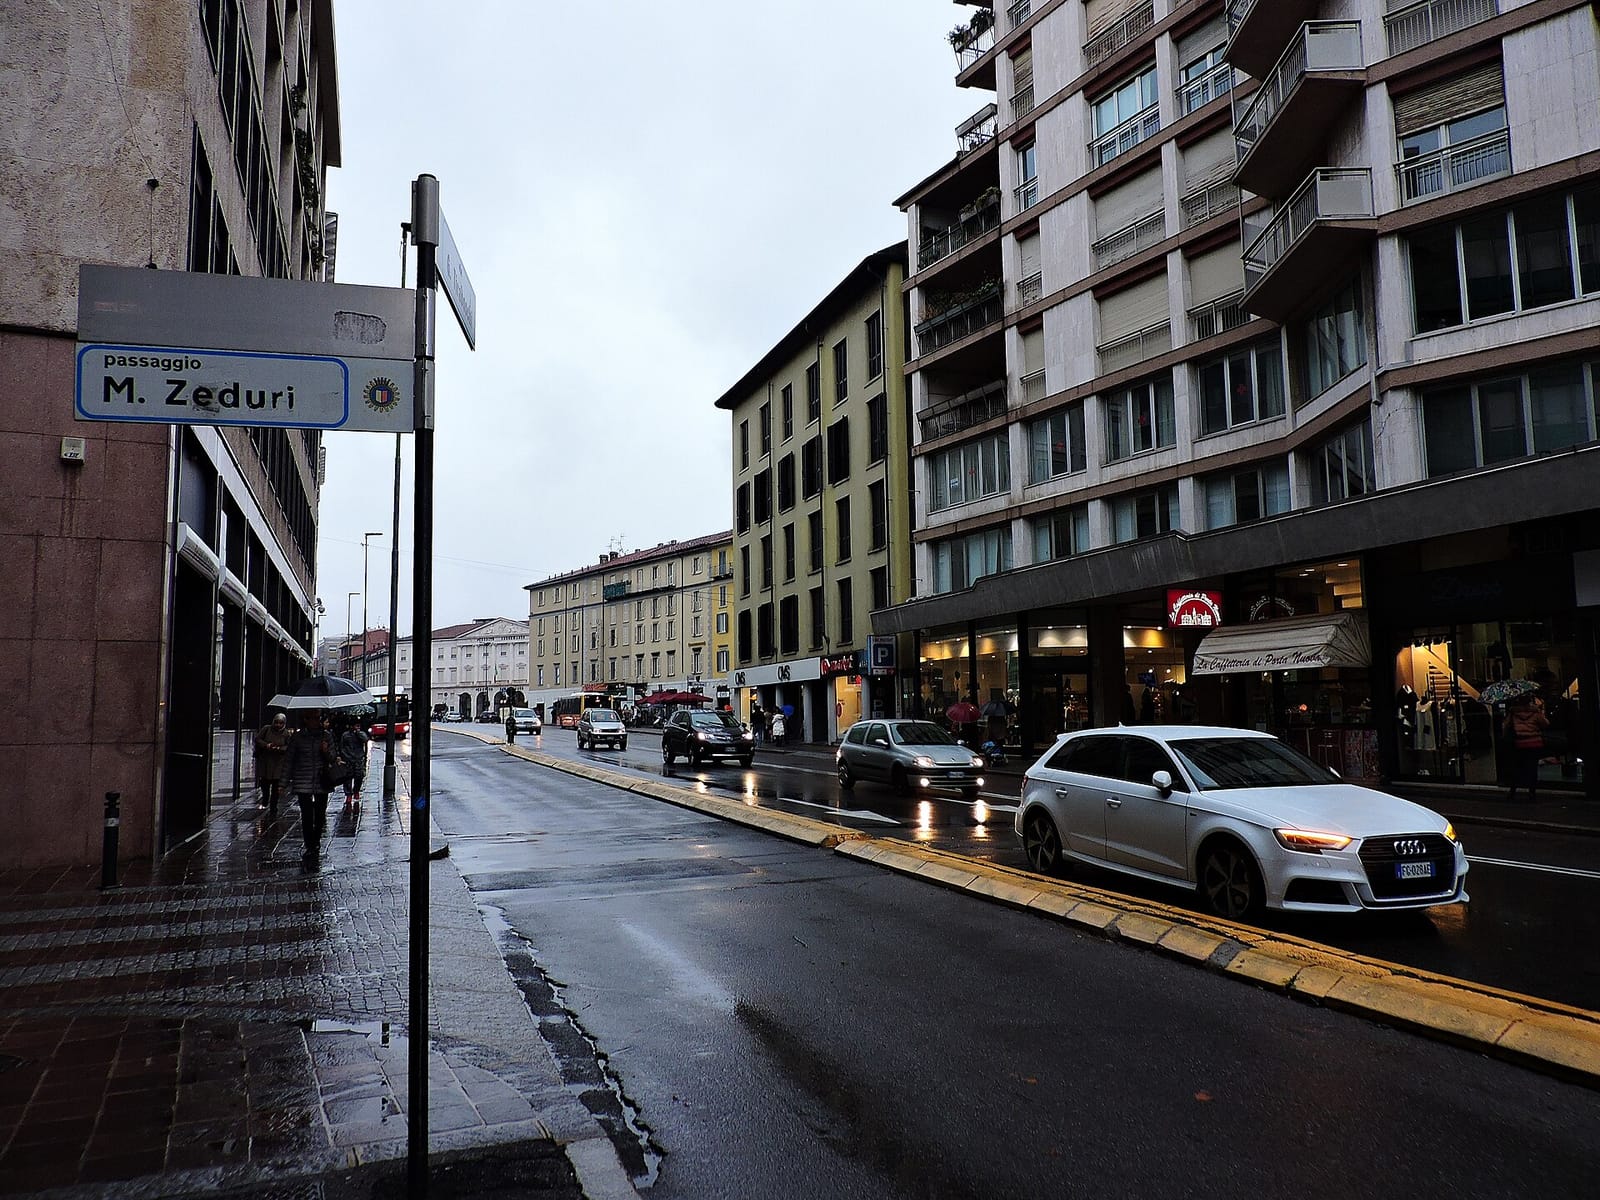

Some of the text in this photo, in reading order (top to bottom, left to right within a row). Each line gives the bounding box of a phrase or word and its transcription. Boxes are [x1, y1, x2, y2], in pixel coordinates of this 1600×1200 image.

[104, 353, 202, 371] passaggio
[103, 376, 295, 410] M. Zeduri
[1197, 658, 1208, 669] La
[1209, 657, 1250, 671] Caffetteria
[1252, 656, 1263, 667] di
[1264, 653, 1288, 666] Porta
